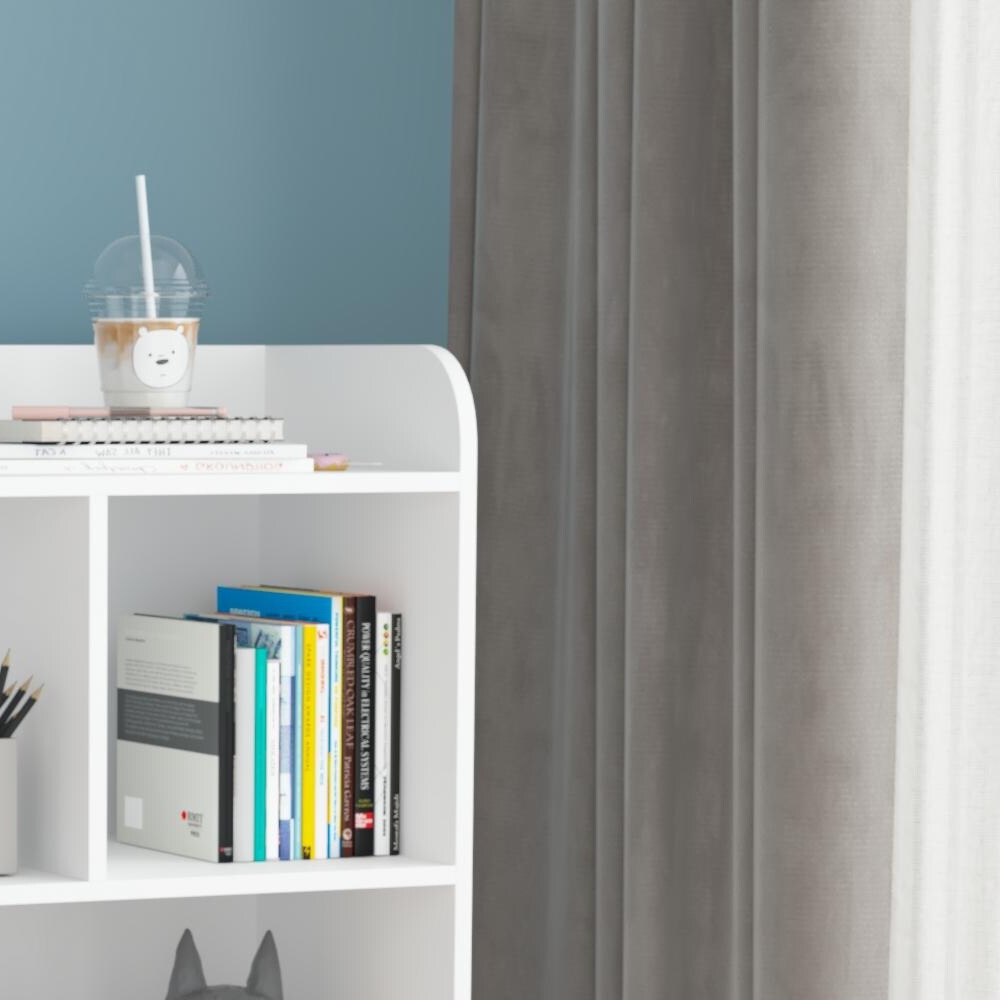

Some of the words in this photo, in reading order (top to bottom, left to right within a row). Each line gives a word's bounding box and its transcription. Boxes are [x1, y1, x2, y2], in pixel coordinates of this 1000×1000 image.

[360, 622, 371, 651] POWER
[359, 652, 371, 690] QUALITY
[345, 688, 355, 717] OAK
[344, 718, 354, 747] LEAF
[360, 698, 371, 749] ELECTRICAL
[359, 751, 370, 791] SYSTEMS
